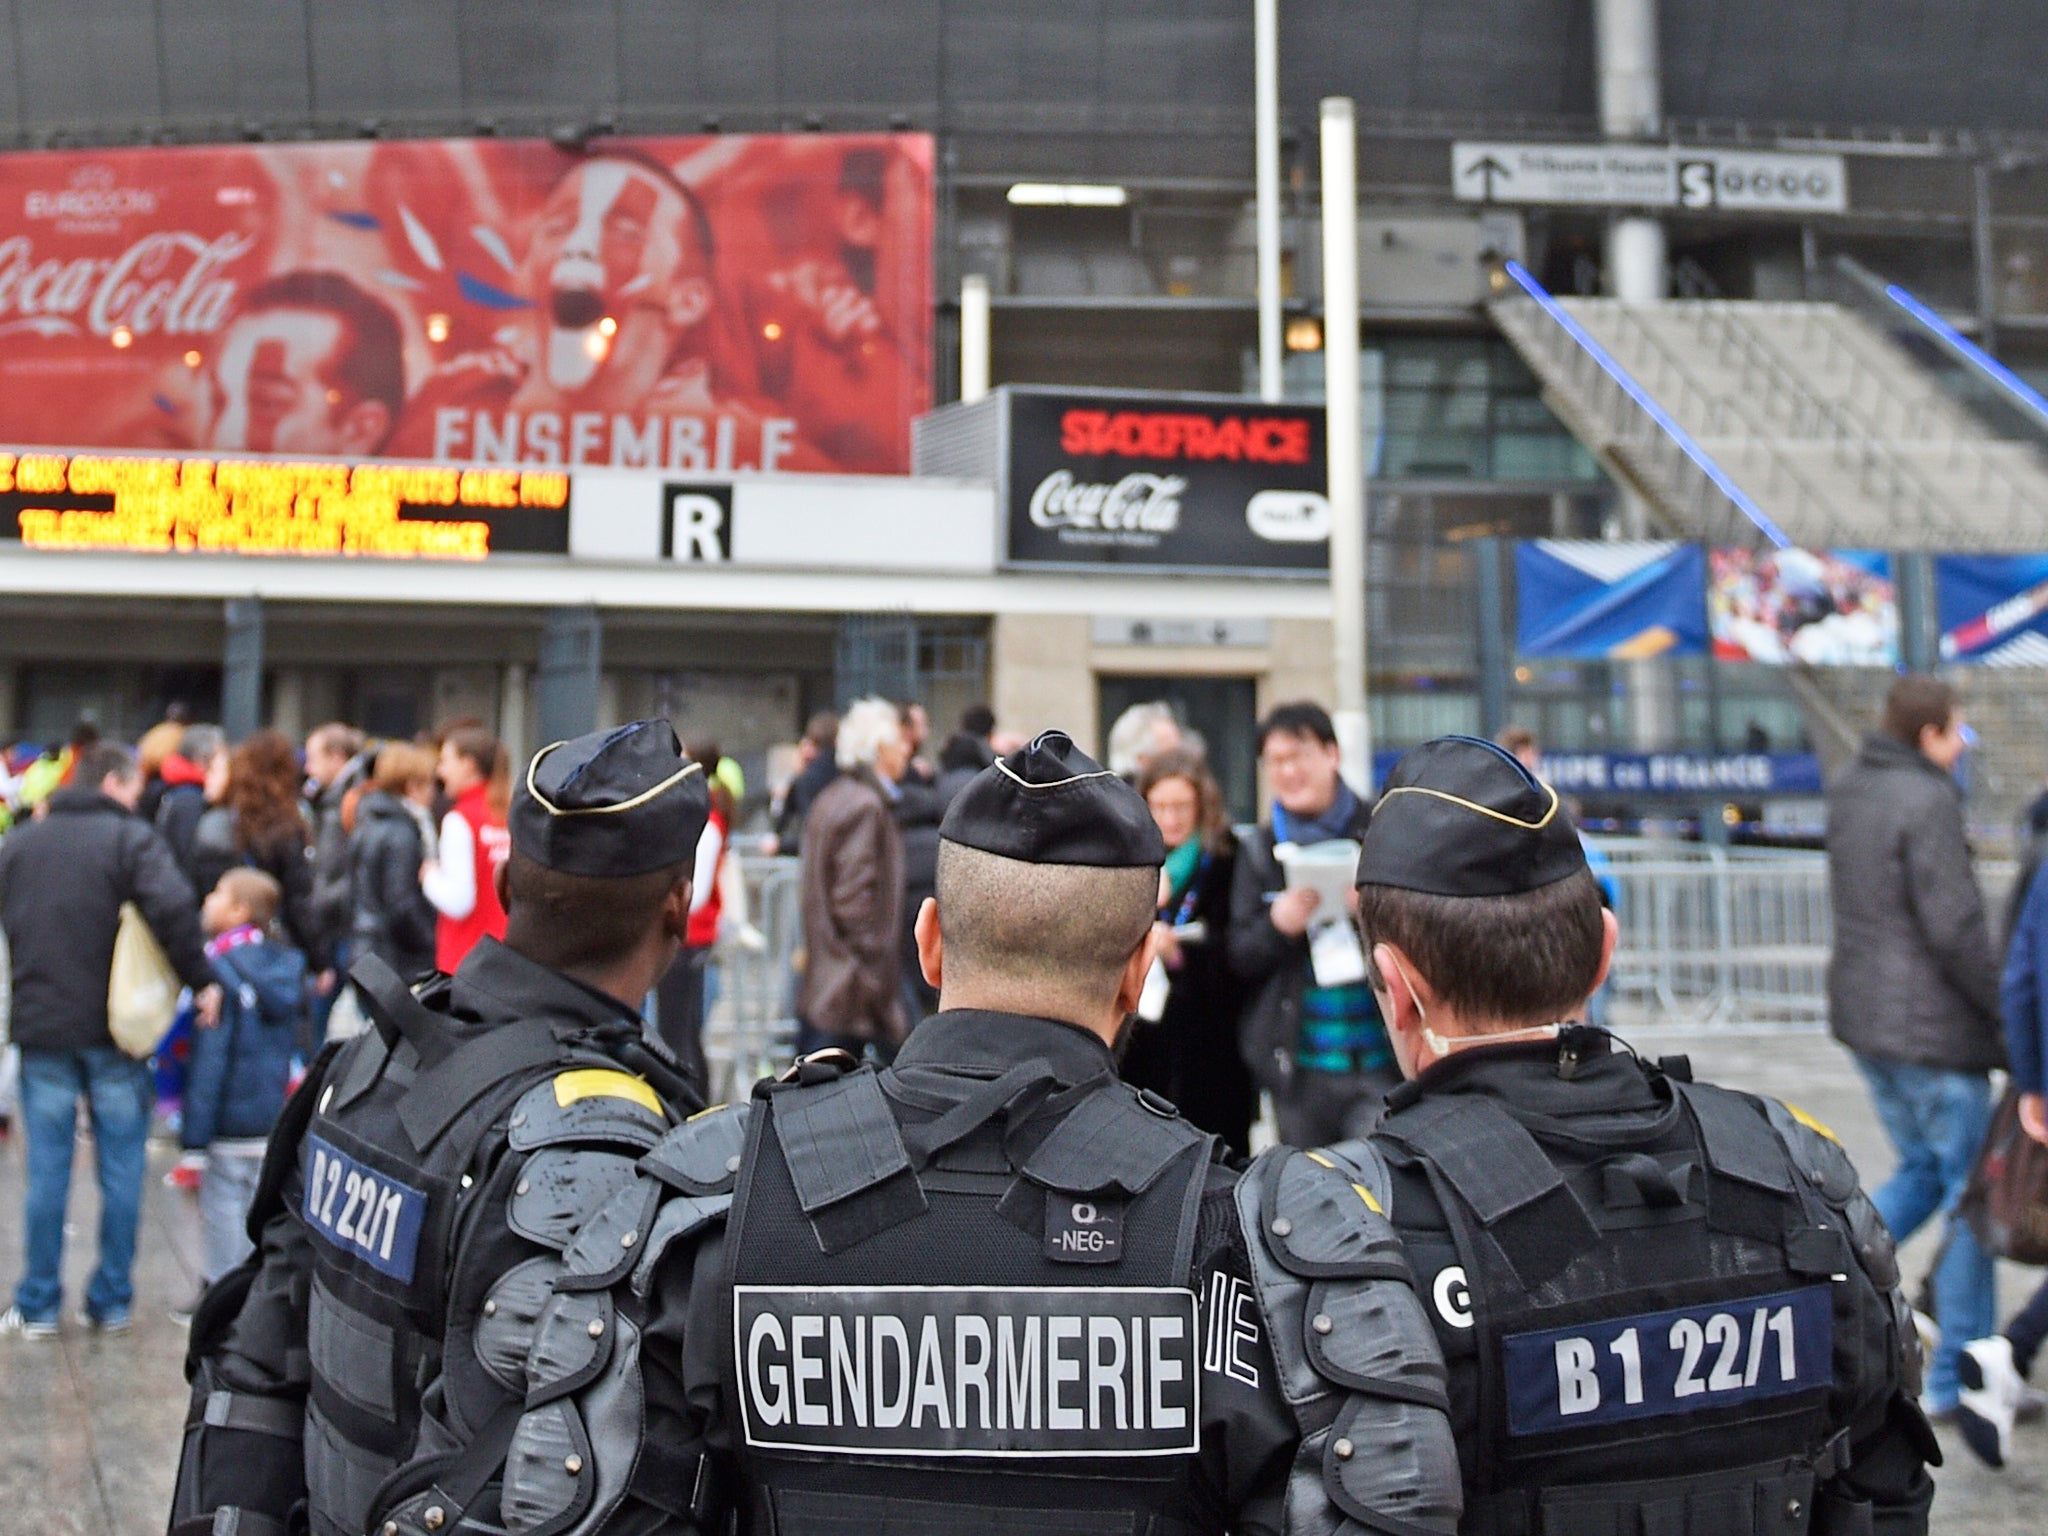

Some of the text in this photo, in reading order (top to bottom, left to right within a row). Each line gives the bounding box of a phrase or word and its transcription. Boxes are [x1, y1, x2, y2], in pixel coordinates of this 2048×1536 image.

[1682, 163, 1714, 208] S
[434, 408, 796, 472] ENSEMBLE
[672, 493, 724, 560] R
[336, 1170, 403, 1261] 22/1
[747, 1312, 1187, 1430] GENDARMERIE
[1203, 1270, 1259, 1389] IE
[1669, 1305, 1797, 1398] 22/1
